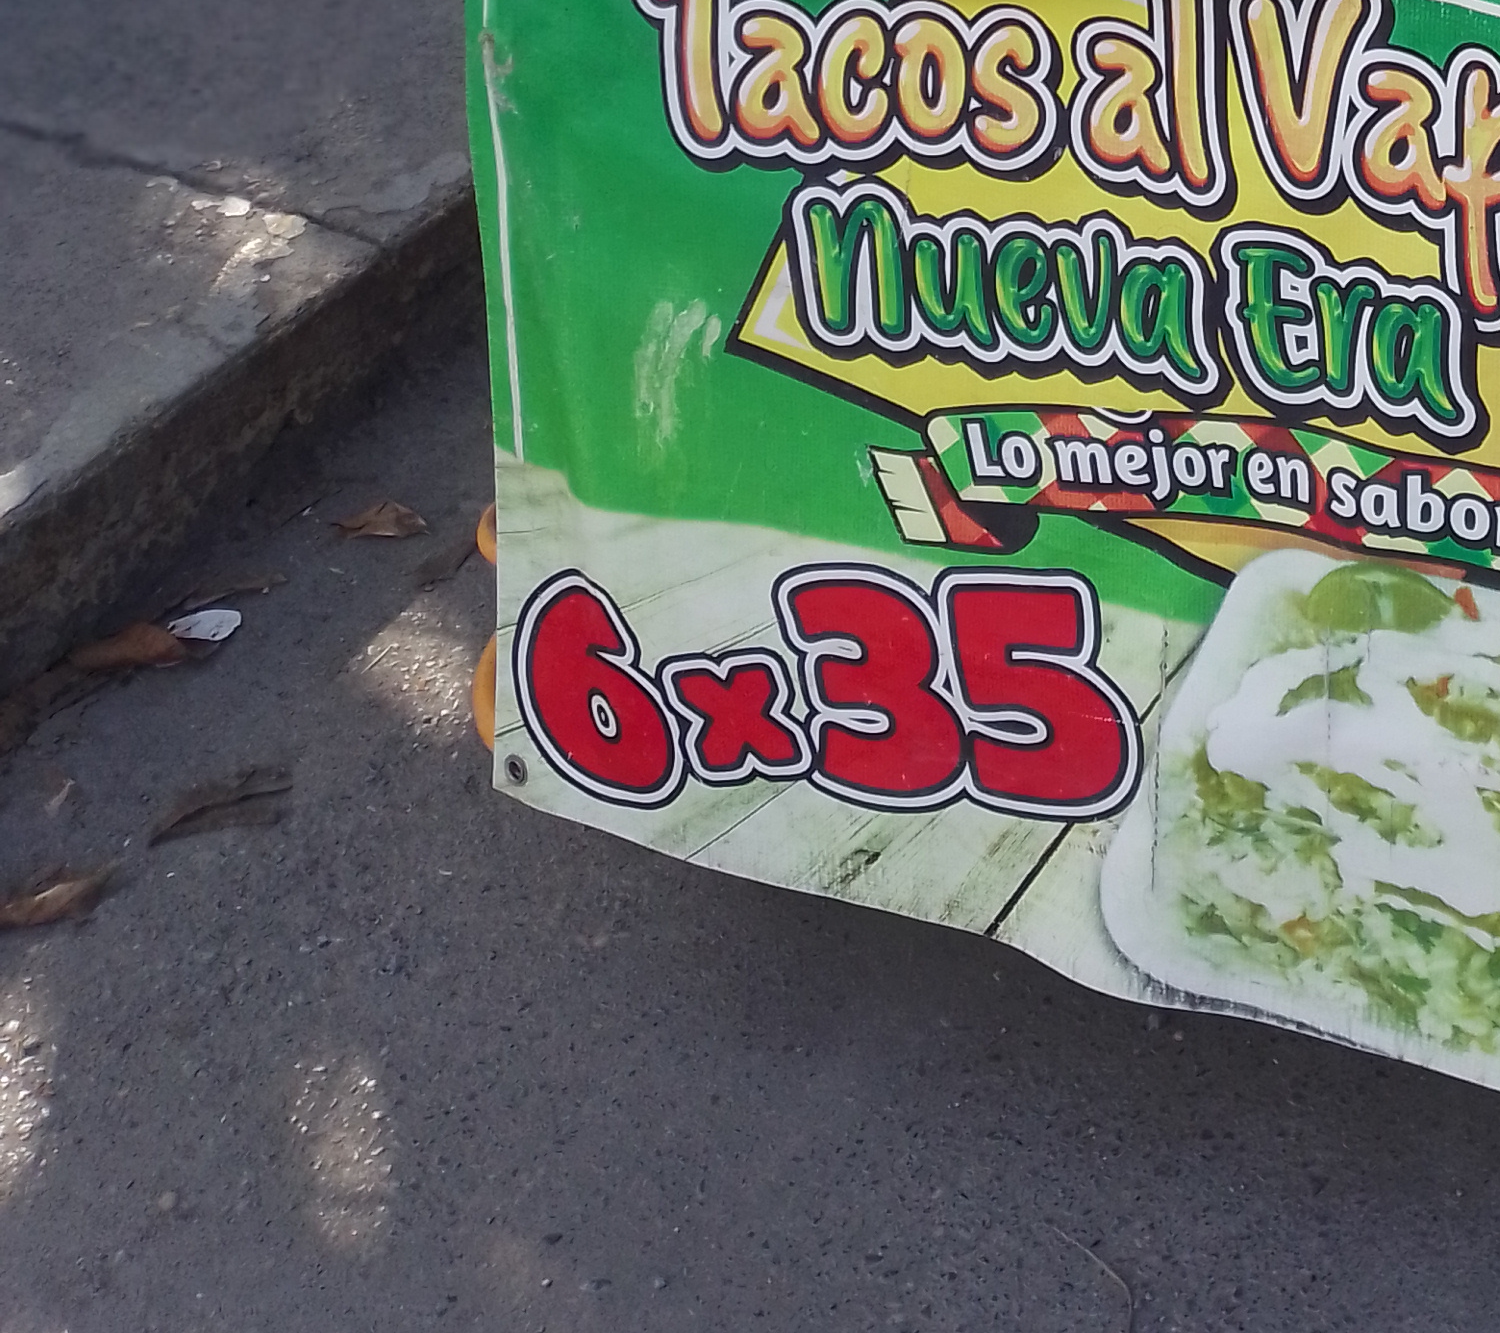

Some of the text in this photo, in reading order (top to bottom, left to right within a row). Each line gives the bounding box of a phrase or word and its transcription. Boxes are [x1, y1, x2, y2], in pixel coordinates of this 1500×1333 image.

[1221, 229, 1478, 437] Era
[964, 421, 1037, 480] Lo
[1056, 429, 1233, 501] mejor
[1246, 451, 1311, 505] en
[514, 565, 1143, 821] 6x35
